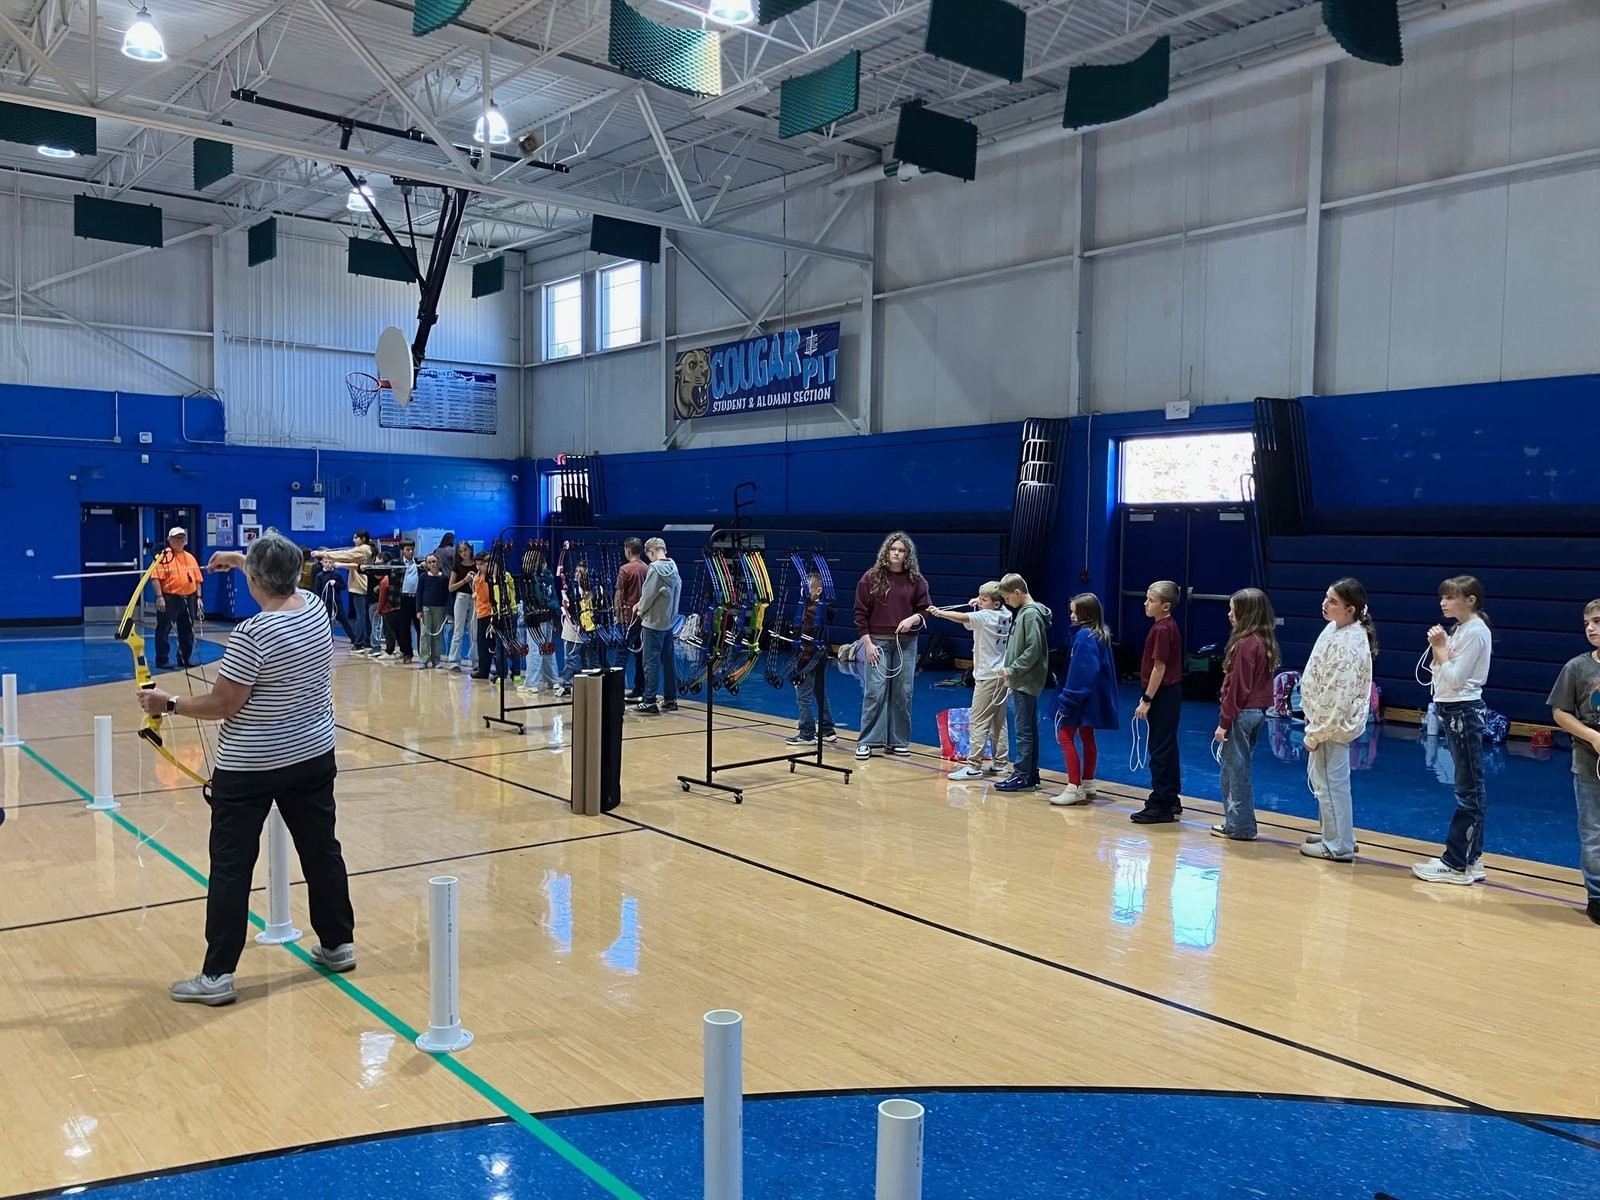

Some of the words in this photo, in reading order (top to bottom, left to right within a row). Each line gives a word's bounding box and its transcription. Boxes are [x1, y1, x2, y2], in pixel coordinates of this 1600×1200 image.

[711, 328, 802, 400] COUGAR
[802, 349, 839, 390] PIT
[712, 397, 747, 413] STUDENT
[748, 397, 755, 409] &
[756, 392, 791, 408] ALUMNI
[793, 386, 832, 404] SECTION
